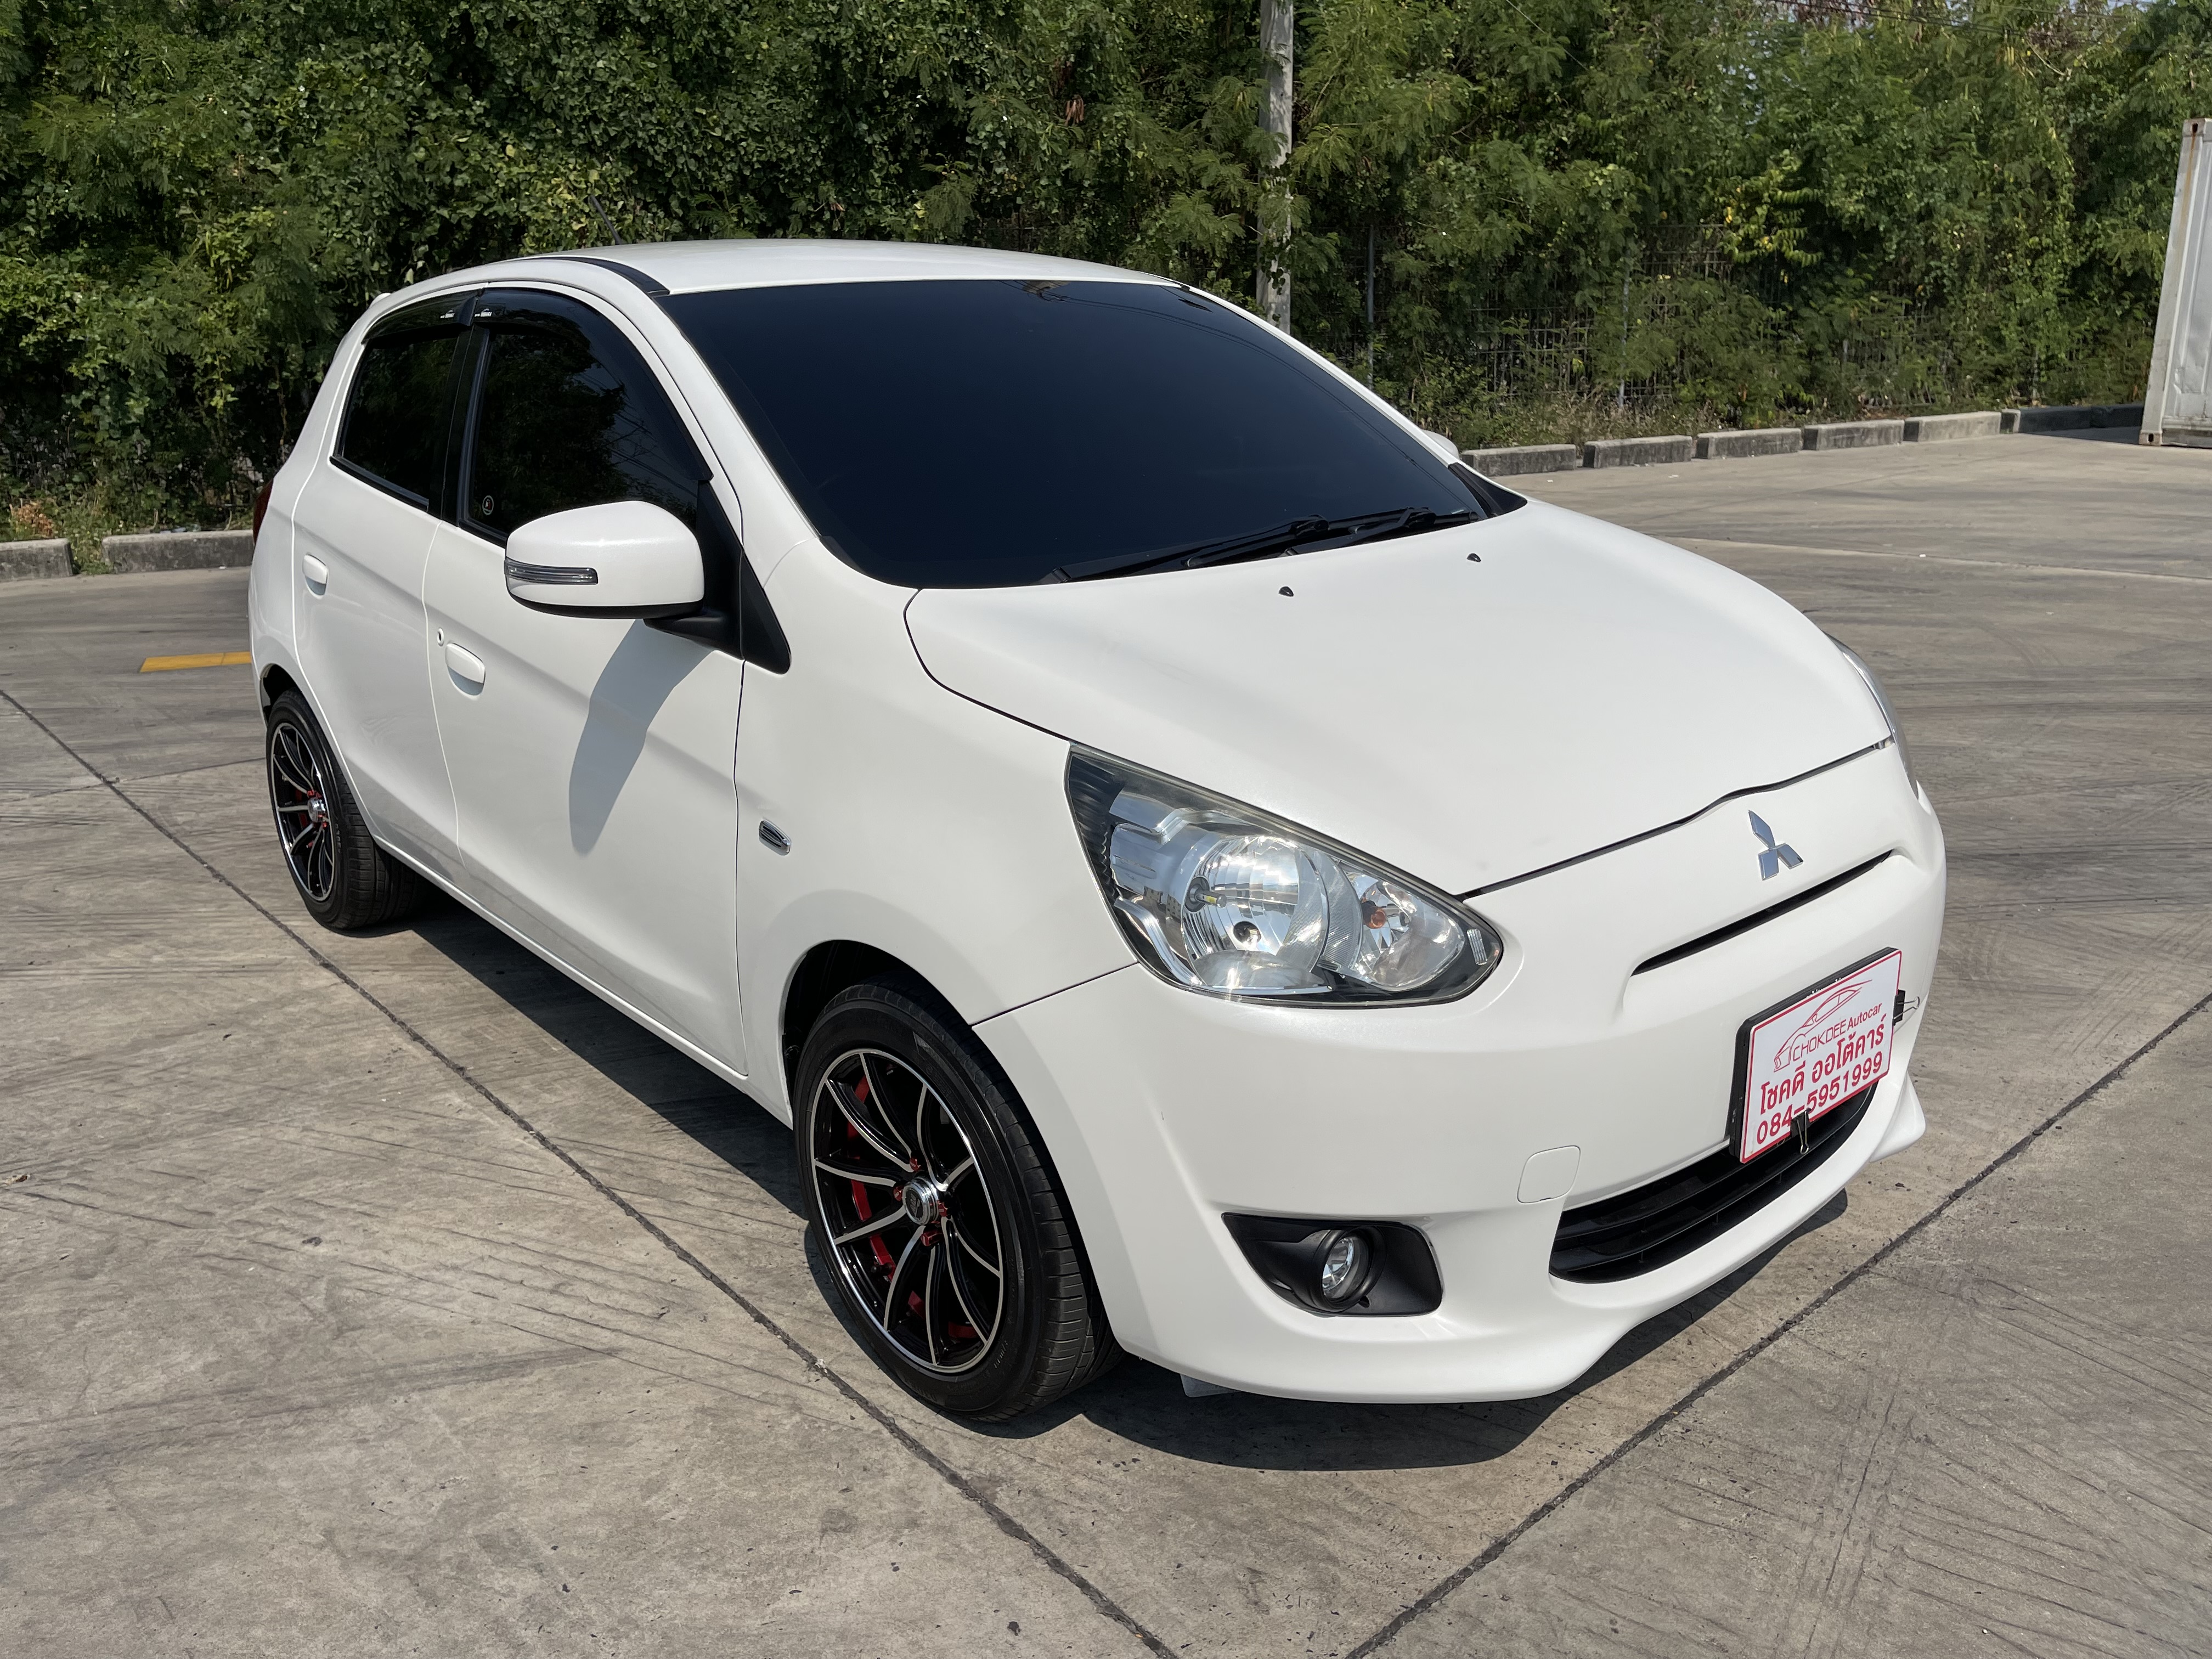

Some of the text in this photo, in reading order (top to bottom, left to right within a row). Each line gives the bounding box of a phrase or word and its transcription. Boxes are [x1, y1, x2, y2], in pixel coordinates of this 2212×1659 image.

[1760, 1013, 1887, 1115] โชคดี ออโต้คาร์
[1793, 1003, 1882, 1062] CHOKDEE Autocar
[1757, 1051, 1882, 1144] 084-5951999
